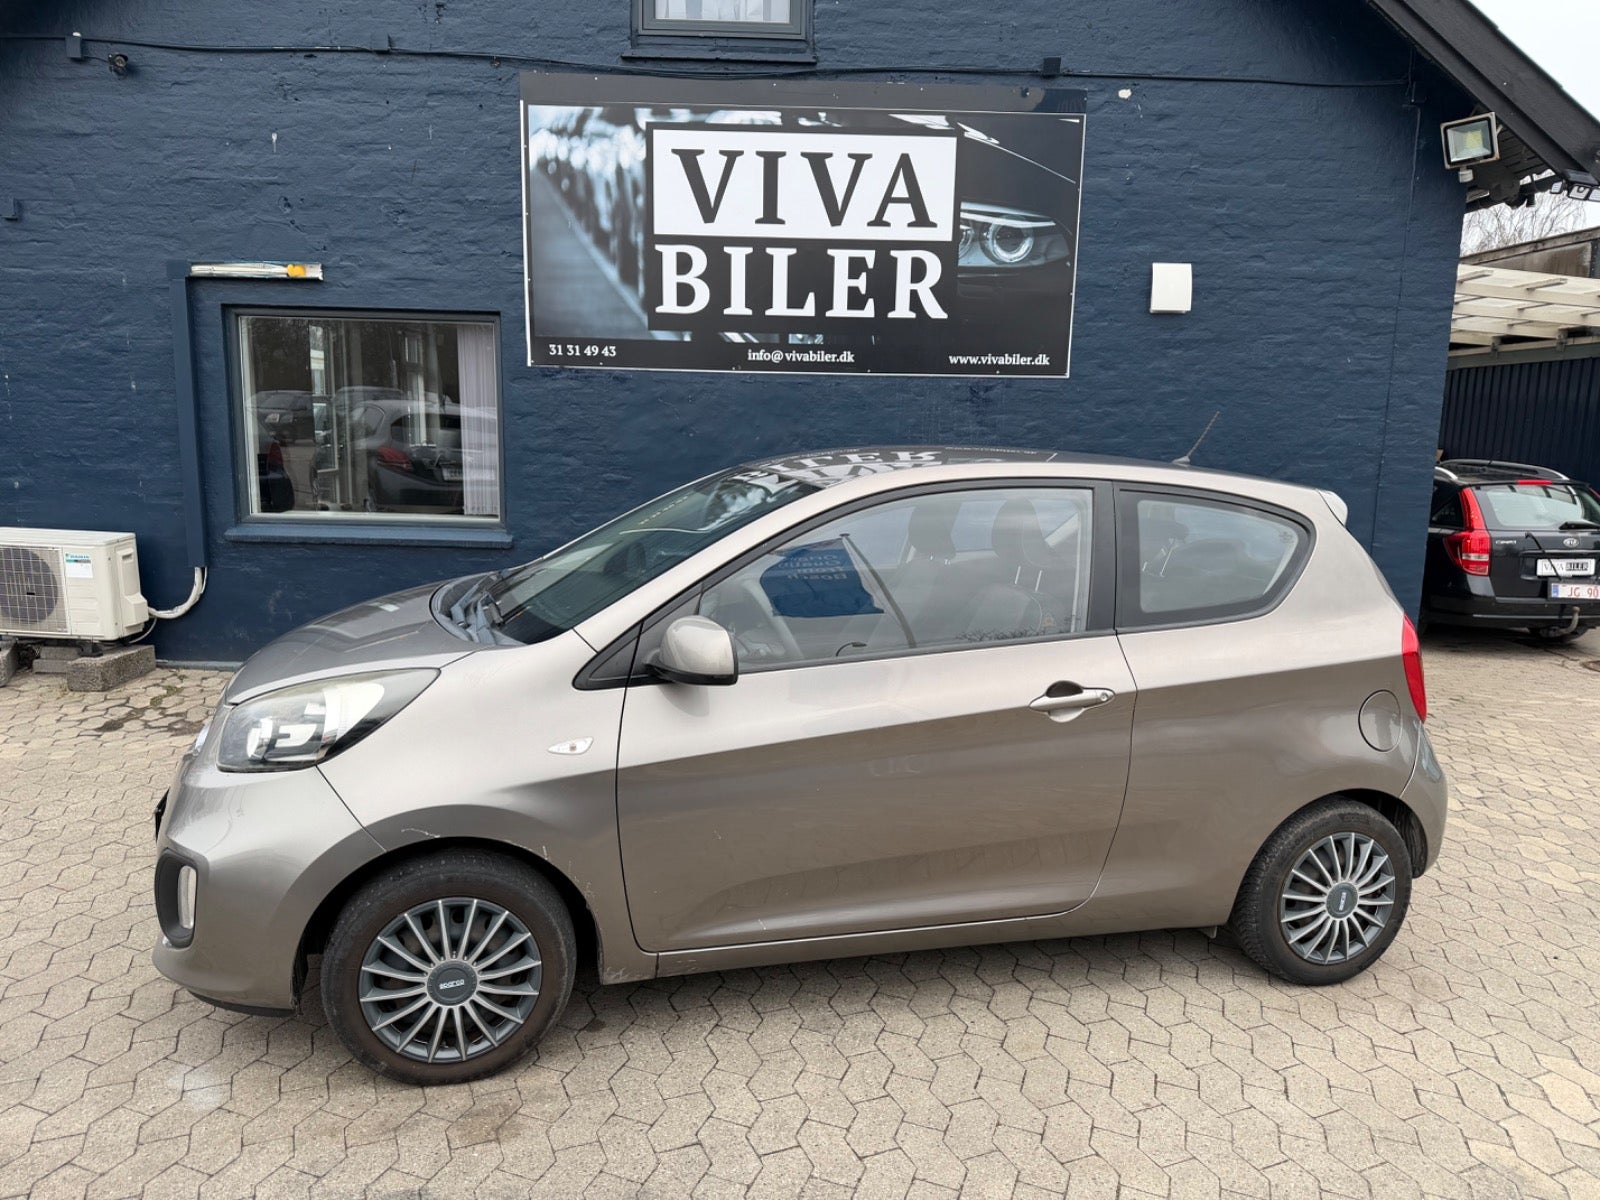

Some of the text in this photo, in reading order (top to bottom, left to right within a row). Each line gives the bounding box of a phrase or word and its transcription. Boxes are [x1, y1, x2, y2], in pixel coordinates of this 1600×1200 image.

[671, 148, 938, 228] VIVA
[654, 243, 949, 319] BILER
[549, 344, 617, 357] 31 31 49 43
[948, 353, 1051, 366] www.vivabiler.dk
[1567, 586, 1599, 599] JG 90
